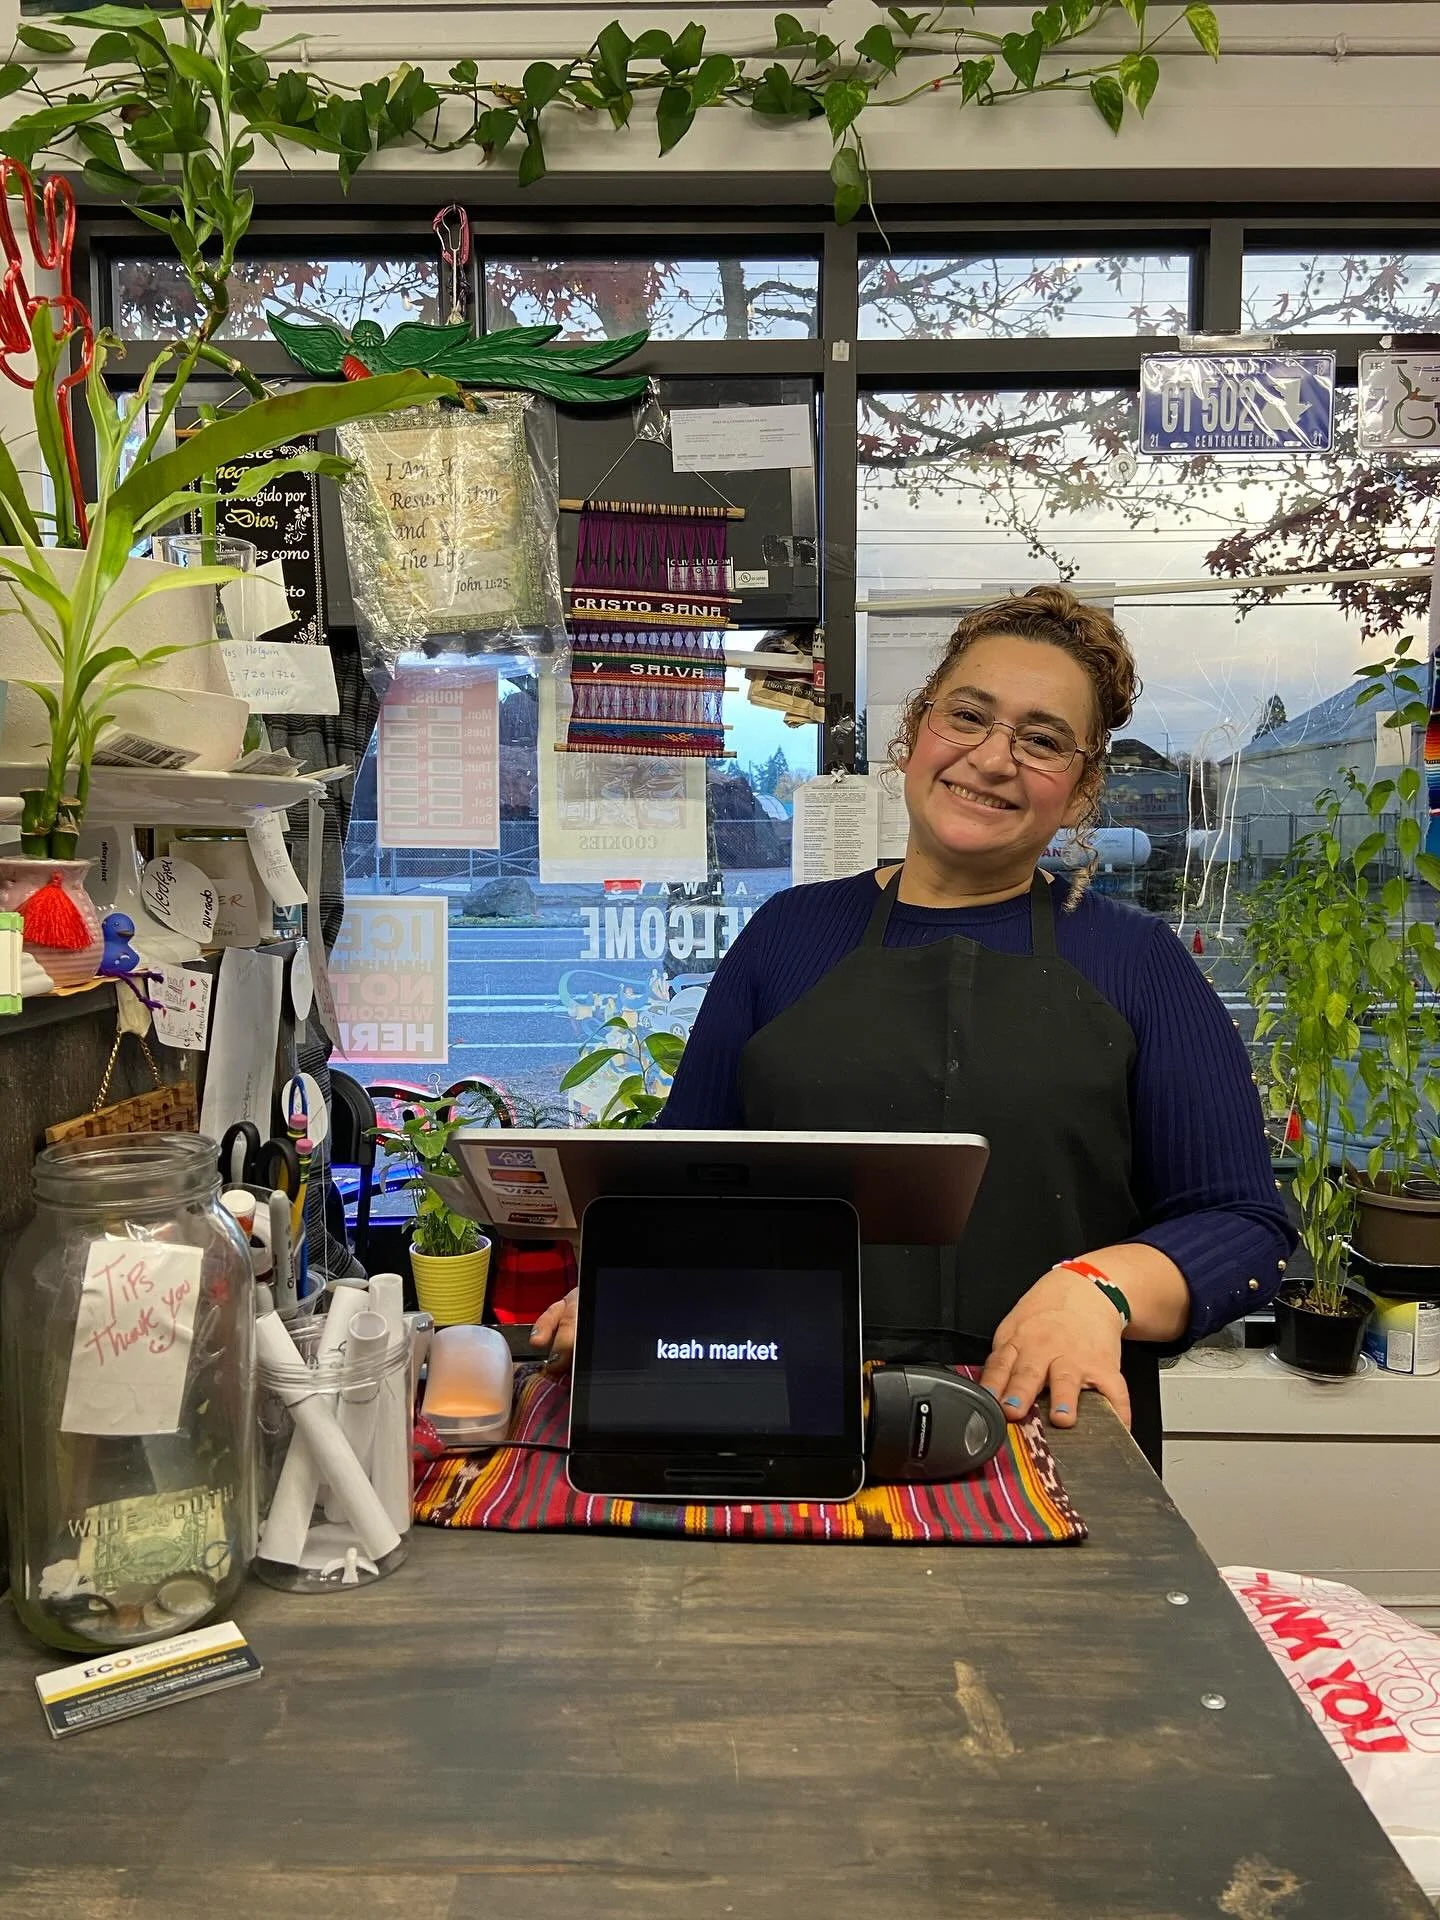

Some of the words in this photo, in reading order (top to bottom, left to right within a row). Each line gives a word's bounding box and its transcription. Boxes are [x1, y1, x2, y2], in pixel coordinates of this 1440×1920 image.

[1161, 378, 1191, 433] GT
[1201, 378, 1256, 433] 502
[1150, 434, 1159, 448] 21
[285, 492, 307, 507] por
[225, 508, 278, 530] Dios;
[395, 517, 429, 540] and
[271, 549, 310, 560] como
[400, 549, 428, 570] The
[433, 550, 465, 573] Life
[454, 577, 481, 595] John
[574, 598, 652, 613] CRISTO
[661, 602, 721, 617] SANA
[630, 663, 705, 679] SALVA
[504, 1187, 545, 1195] VISA
[657, 1339, 703, 1359] kaah
[709, 1339, 778, 1360] market
[83, 1657, 132, 1680] ECO
[1306, 1659, 1409, 1752] YOU
